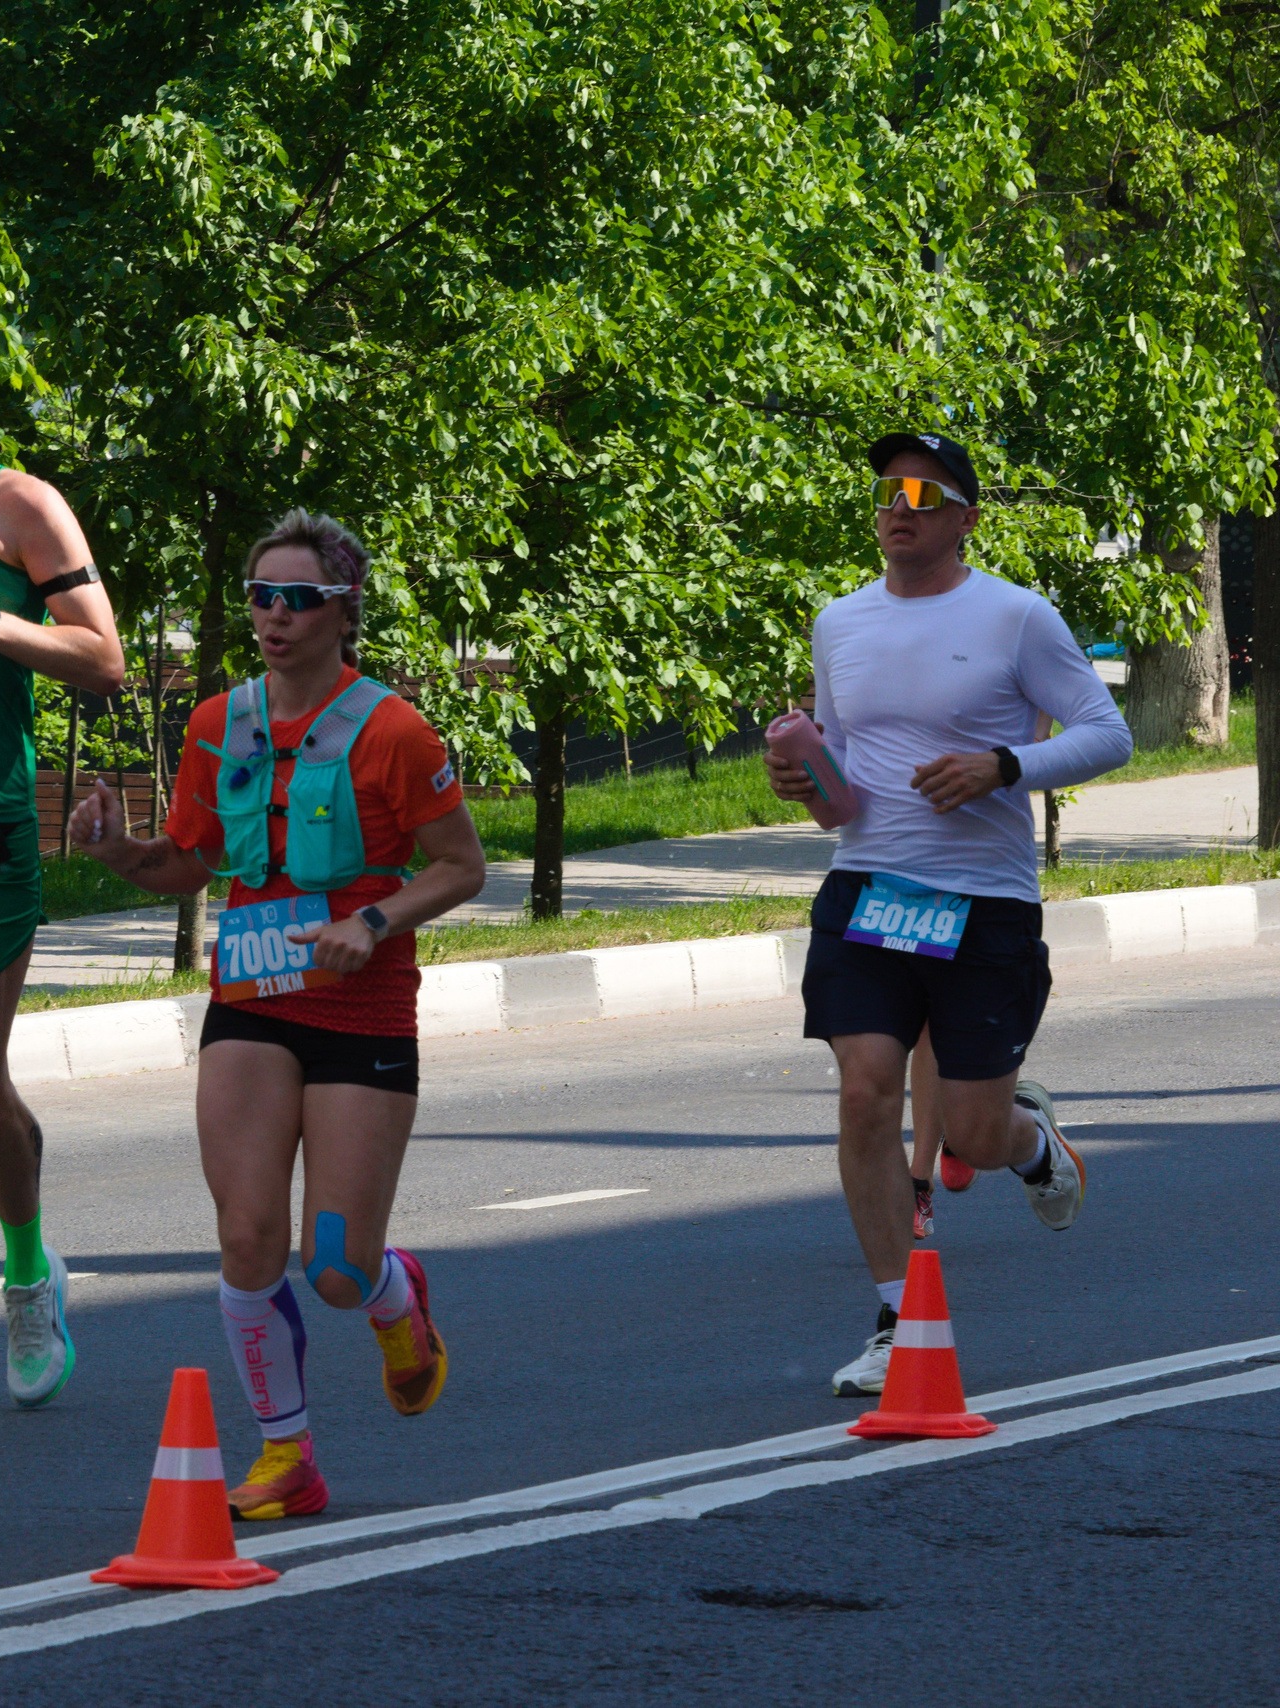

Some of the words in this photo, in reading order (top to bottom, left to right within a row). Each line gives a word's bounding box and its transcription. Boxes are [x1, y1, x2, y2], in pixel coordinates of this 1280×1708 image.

[859, 899, 957, 943] 50149
[882, 936, 919, 953] 10KM
[256, 971, 305, 998] 21.1KM
